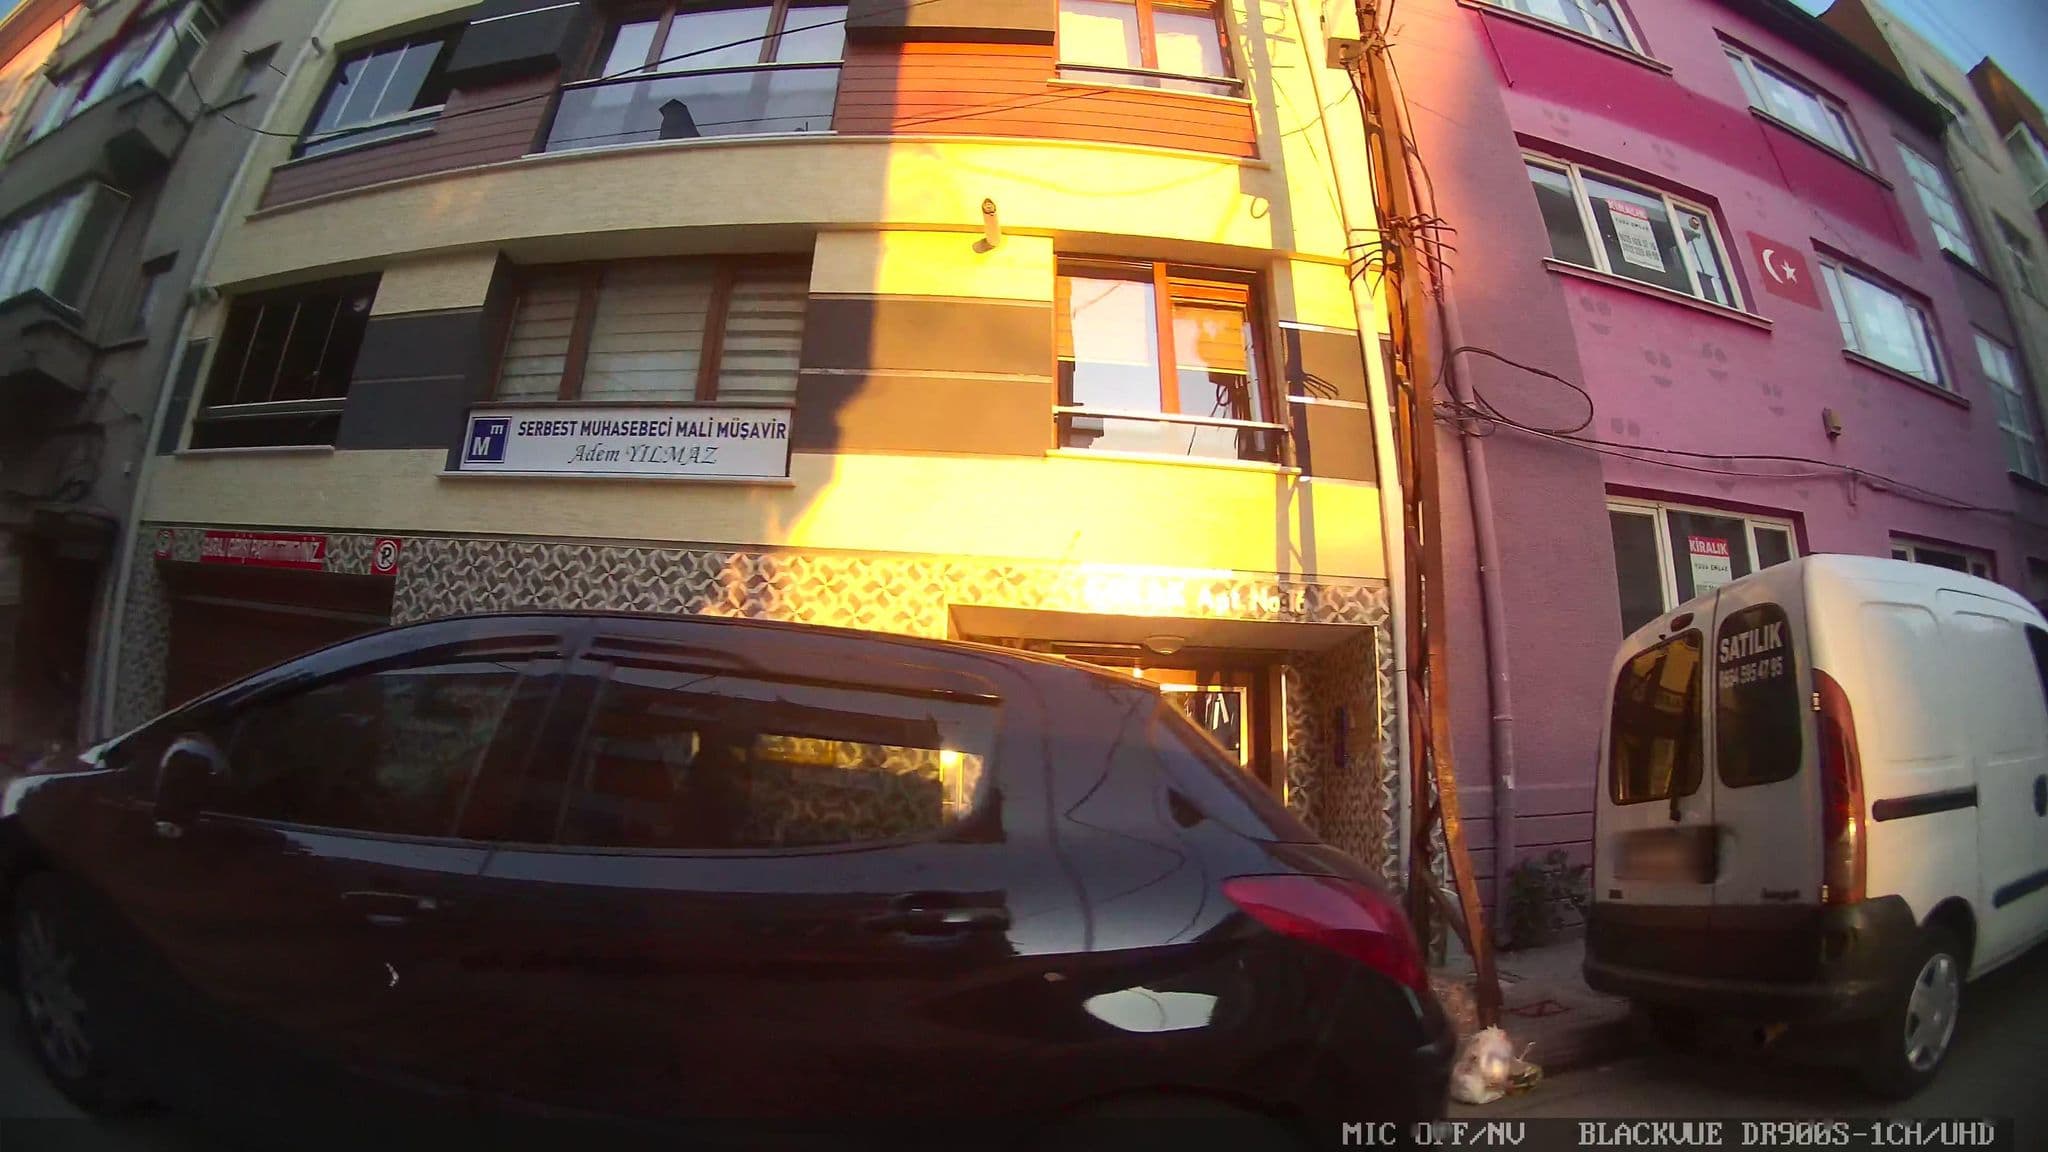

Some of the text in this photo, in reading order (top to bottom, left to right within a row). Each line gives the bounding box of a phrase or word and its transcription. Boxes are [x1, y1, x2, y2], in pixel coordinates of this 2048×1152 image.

[517, 416, 787, 440] SERBEST MUHASEBECİ MALİ MÜŞAVİR
[567, 442, 719, 466] Adem YILMAZ
[1689, 538, 1729, 555] KİRALIK
[1720, 621, 1784, 663] SATILIK
